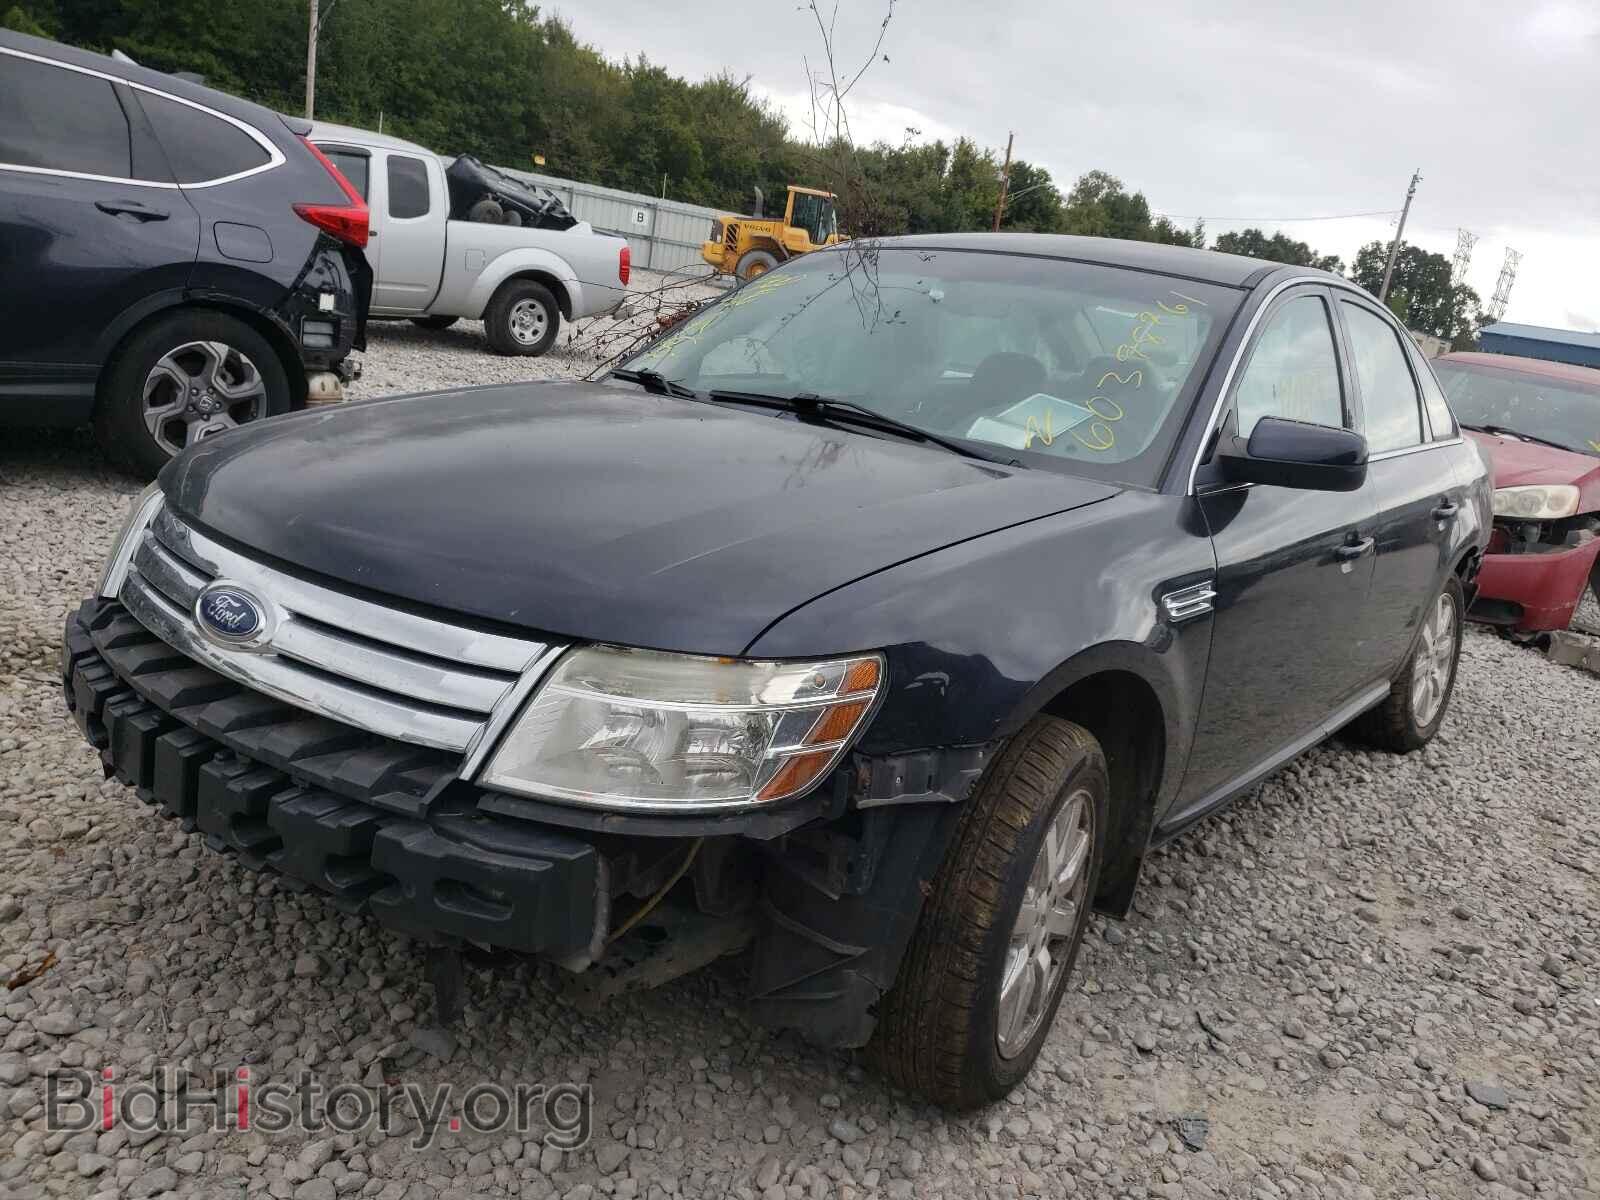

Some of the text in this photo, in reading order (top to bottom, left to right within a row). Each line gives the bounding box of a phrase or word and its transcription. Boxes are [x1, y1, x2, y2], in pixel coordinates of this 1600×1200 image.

[637, 211, 644, 222] B
[744, 223, 772, 233] VOLVO
[208, 595, 247, 629] Ford
